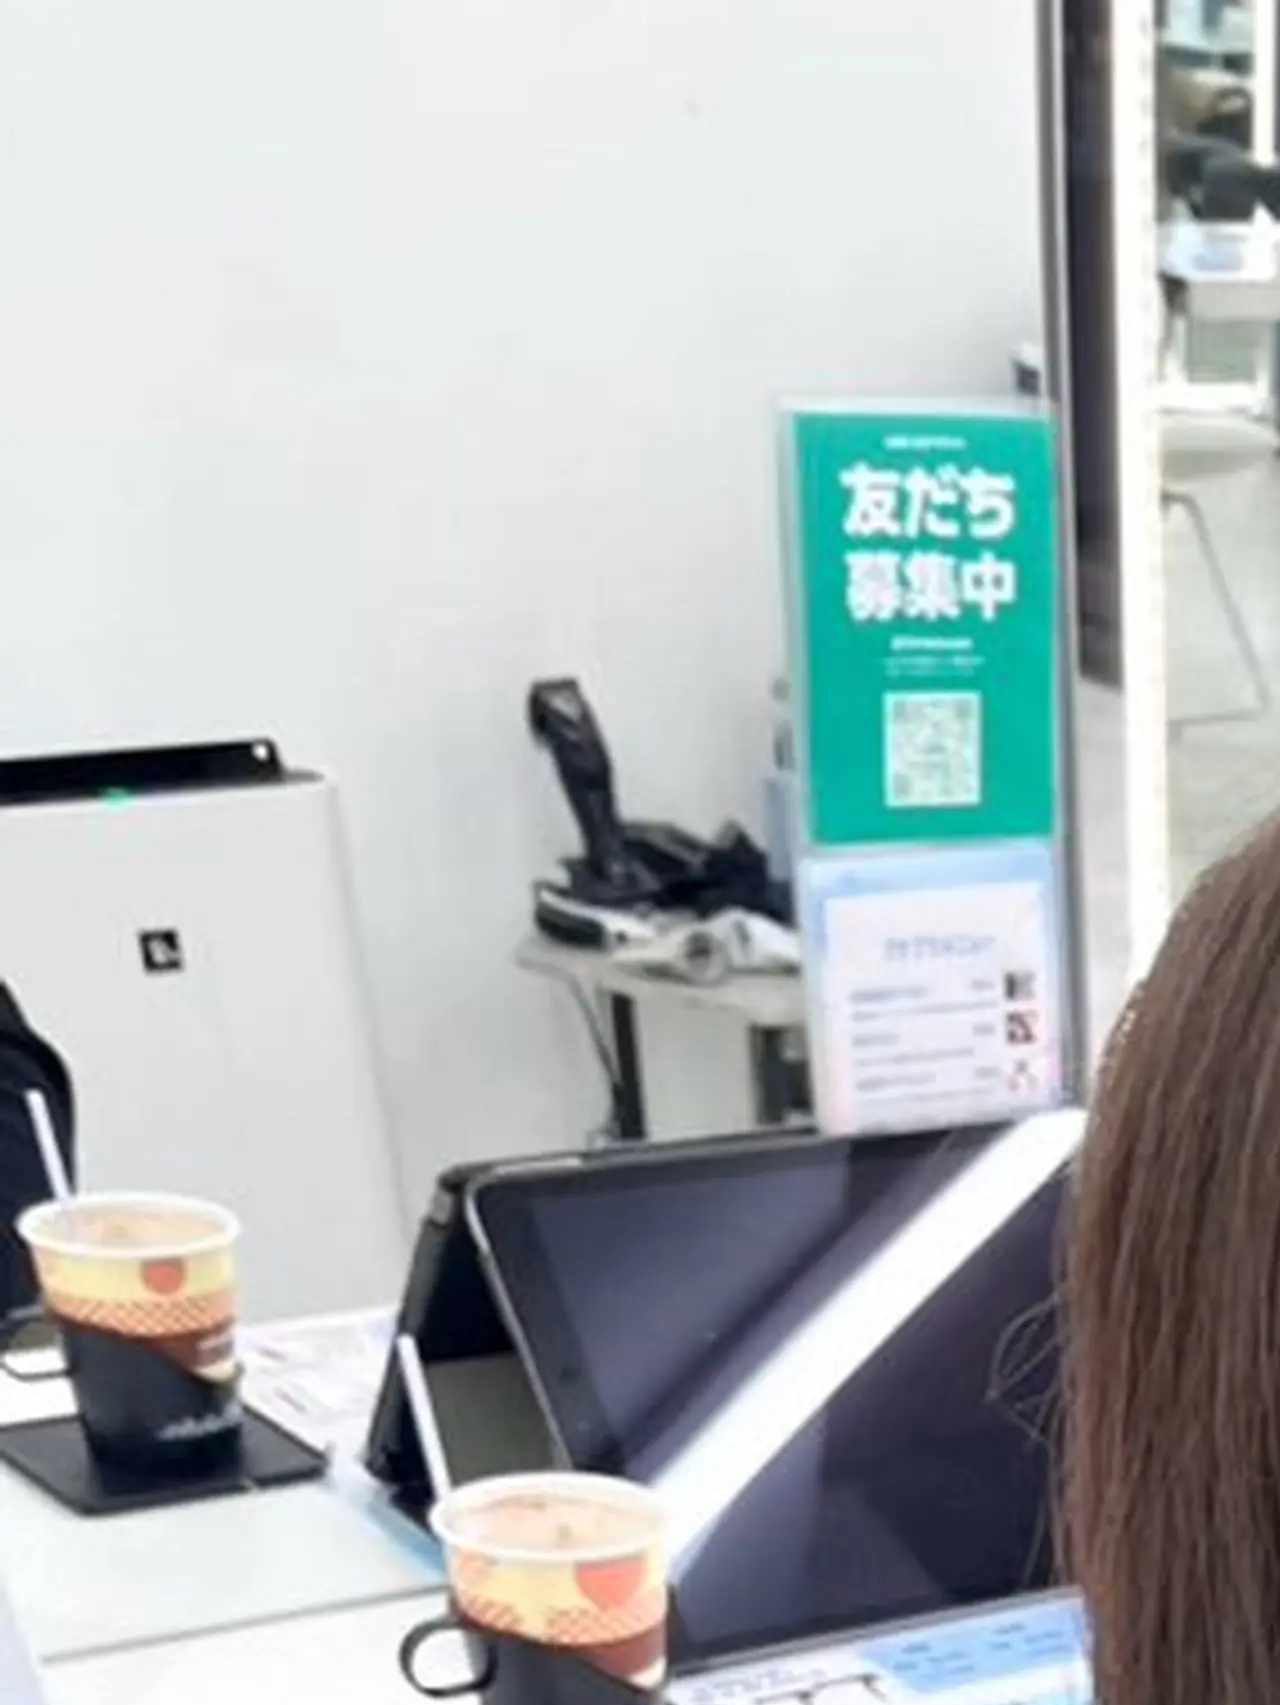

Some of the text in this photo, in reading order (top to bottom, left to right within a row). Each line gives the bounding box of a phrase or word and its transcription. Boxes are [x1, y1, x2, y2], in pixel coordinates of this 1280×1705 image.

[839, 463, 1015, 538] 友だち
[845, 551, 1017, 621] 募集中
